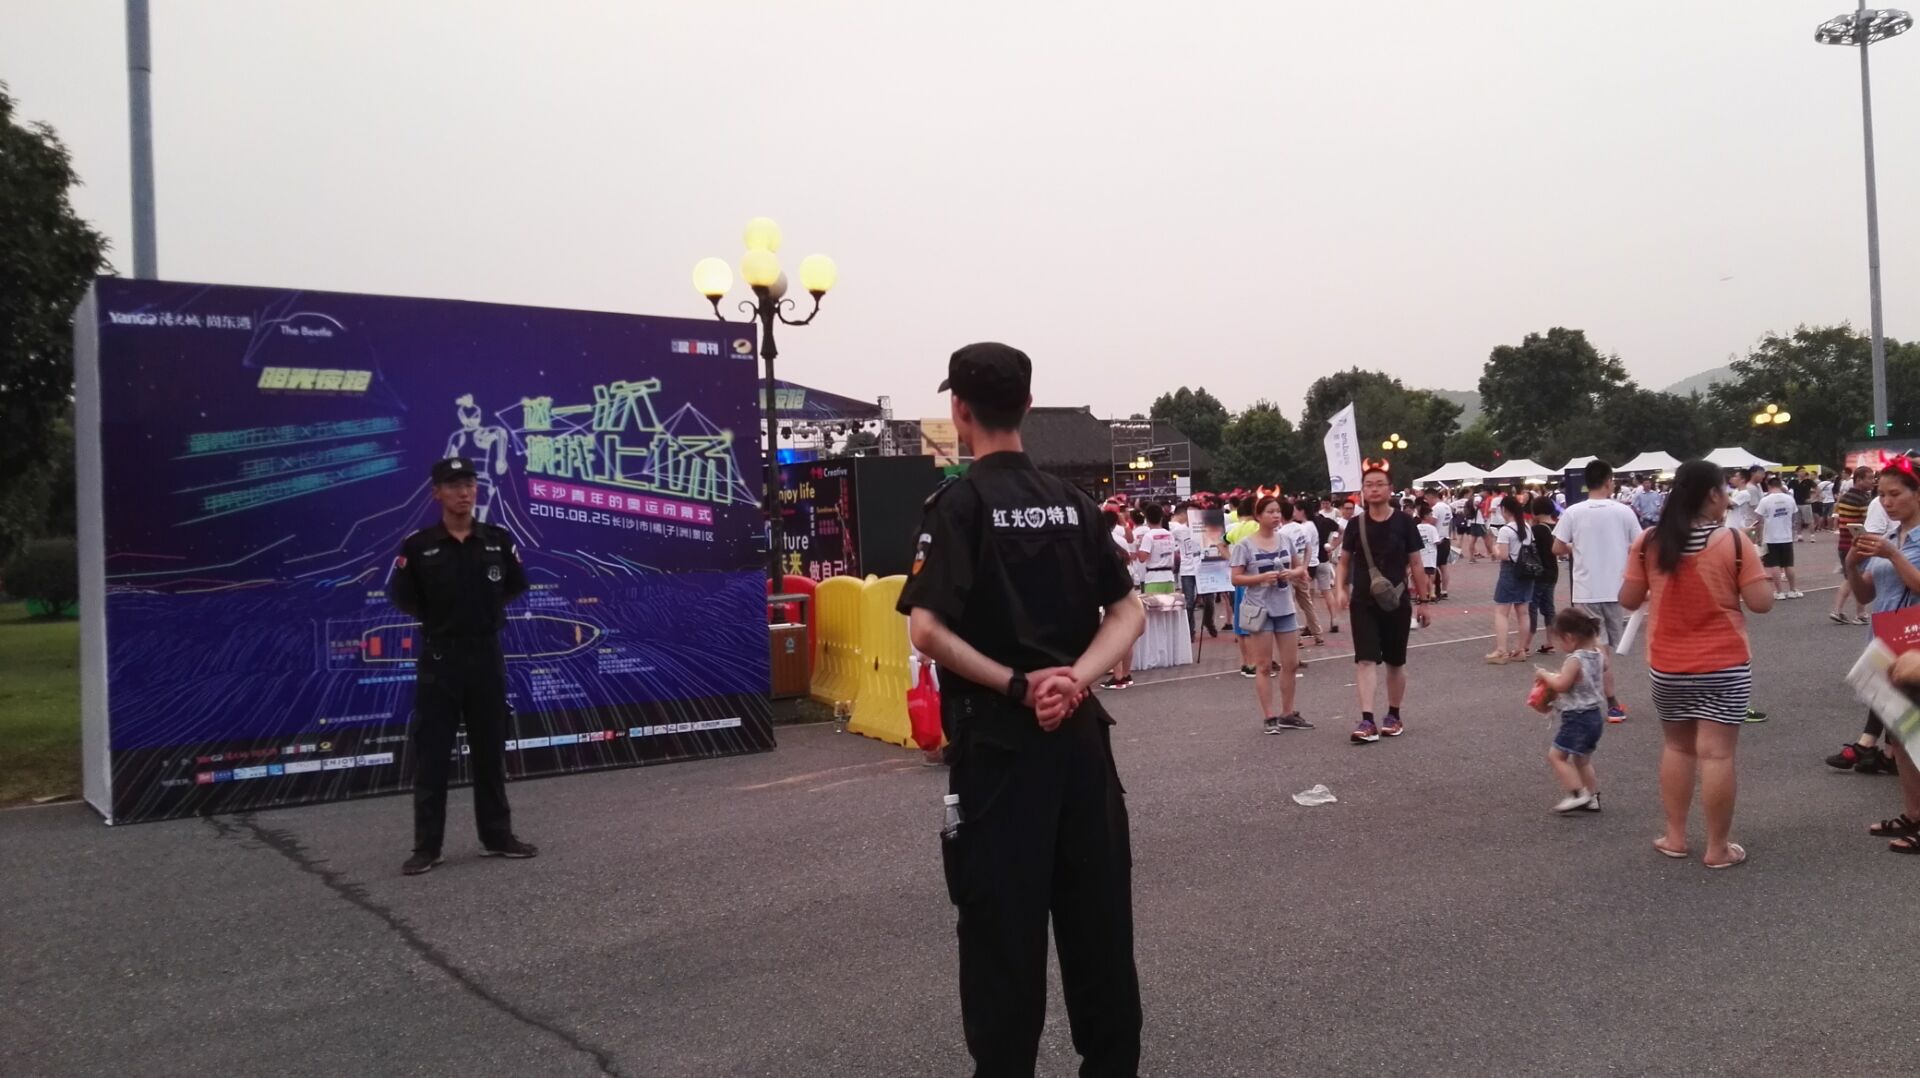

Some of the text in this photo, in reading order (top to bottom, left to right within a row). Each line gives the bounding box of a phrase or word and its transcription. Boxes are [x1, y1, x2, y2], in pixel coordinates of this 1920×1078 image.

[281, 325, 332, 337] The Beetle
[823, 467, 848, 477] Creative
[800, 482, 815, 499] life
[530, 503, 611, 526] 2016.08.25
[993, 508, 1026, 528] 红光
